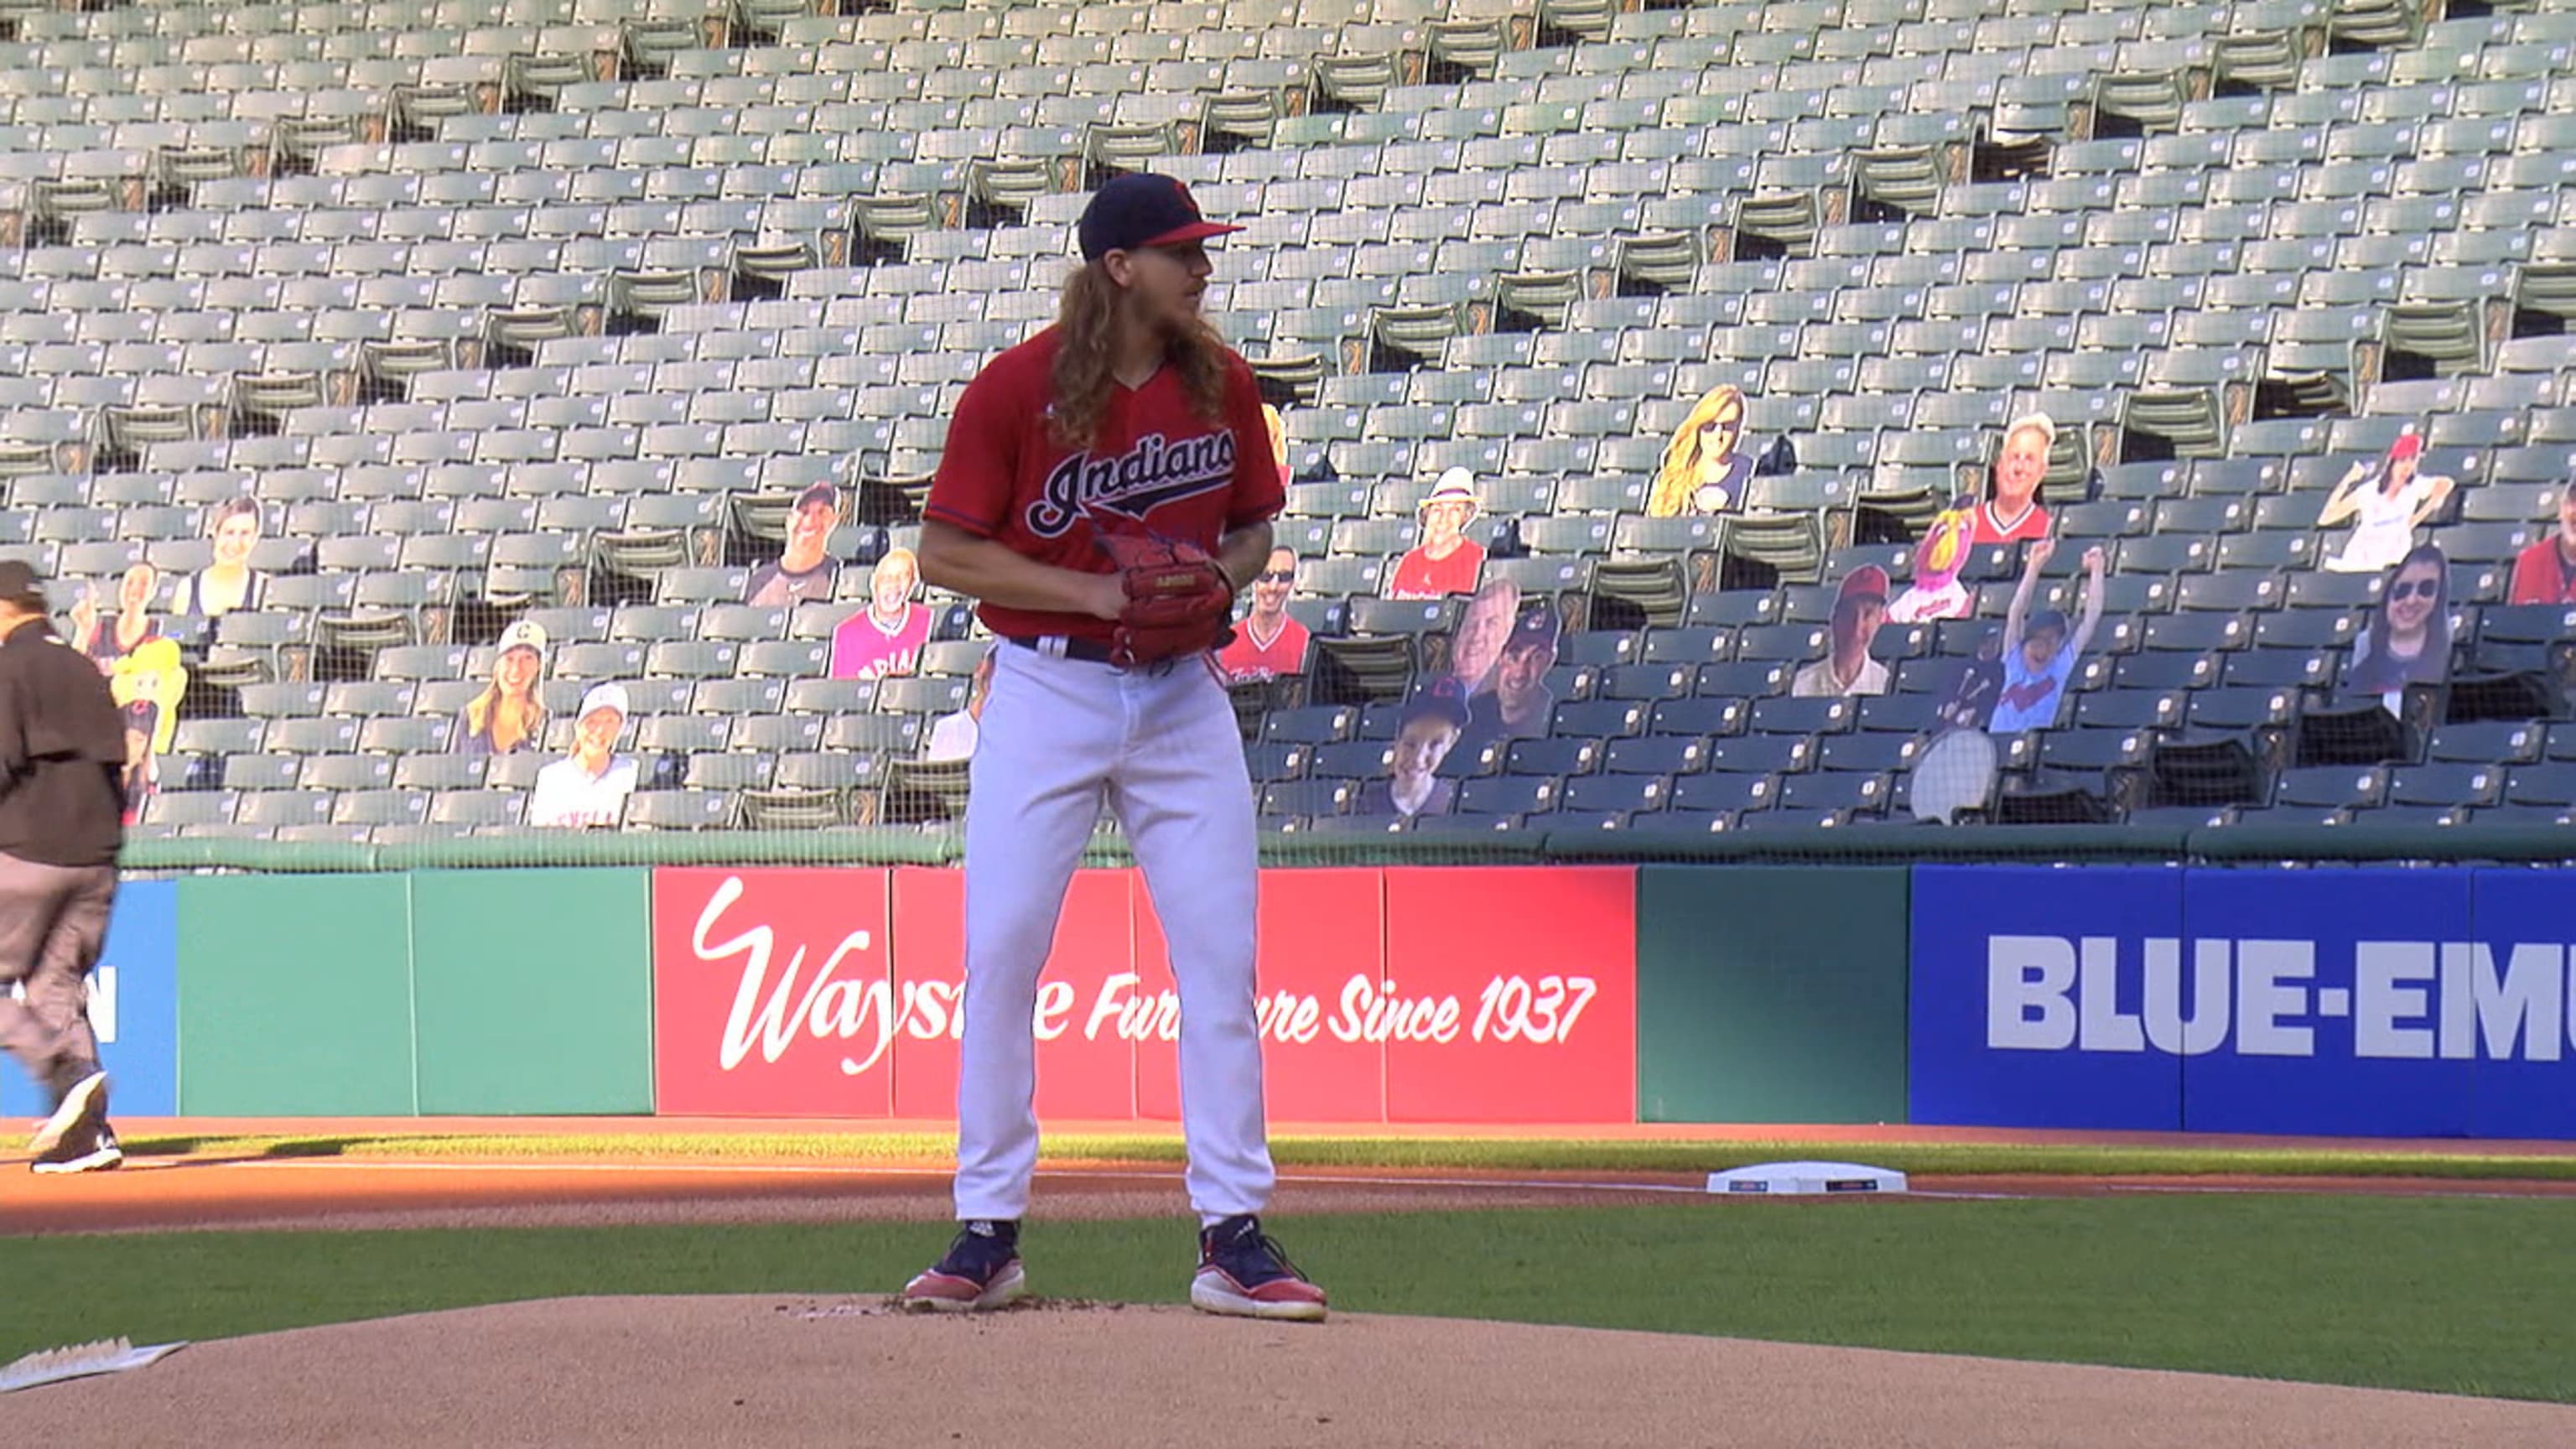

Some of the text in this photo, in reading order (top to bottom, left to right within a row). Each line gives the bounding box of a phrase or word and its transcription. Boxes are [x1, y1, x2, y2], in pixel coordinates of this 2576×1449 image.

[1026, 429, 1236, 538] Indians
[1327, 974, 1461, 1044] Since
[1471, 974, 1597, 1044] 1937
[1987, 935, 2576, 1062] BLUE-EM
